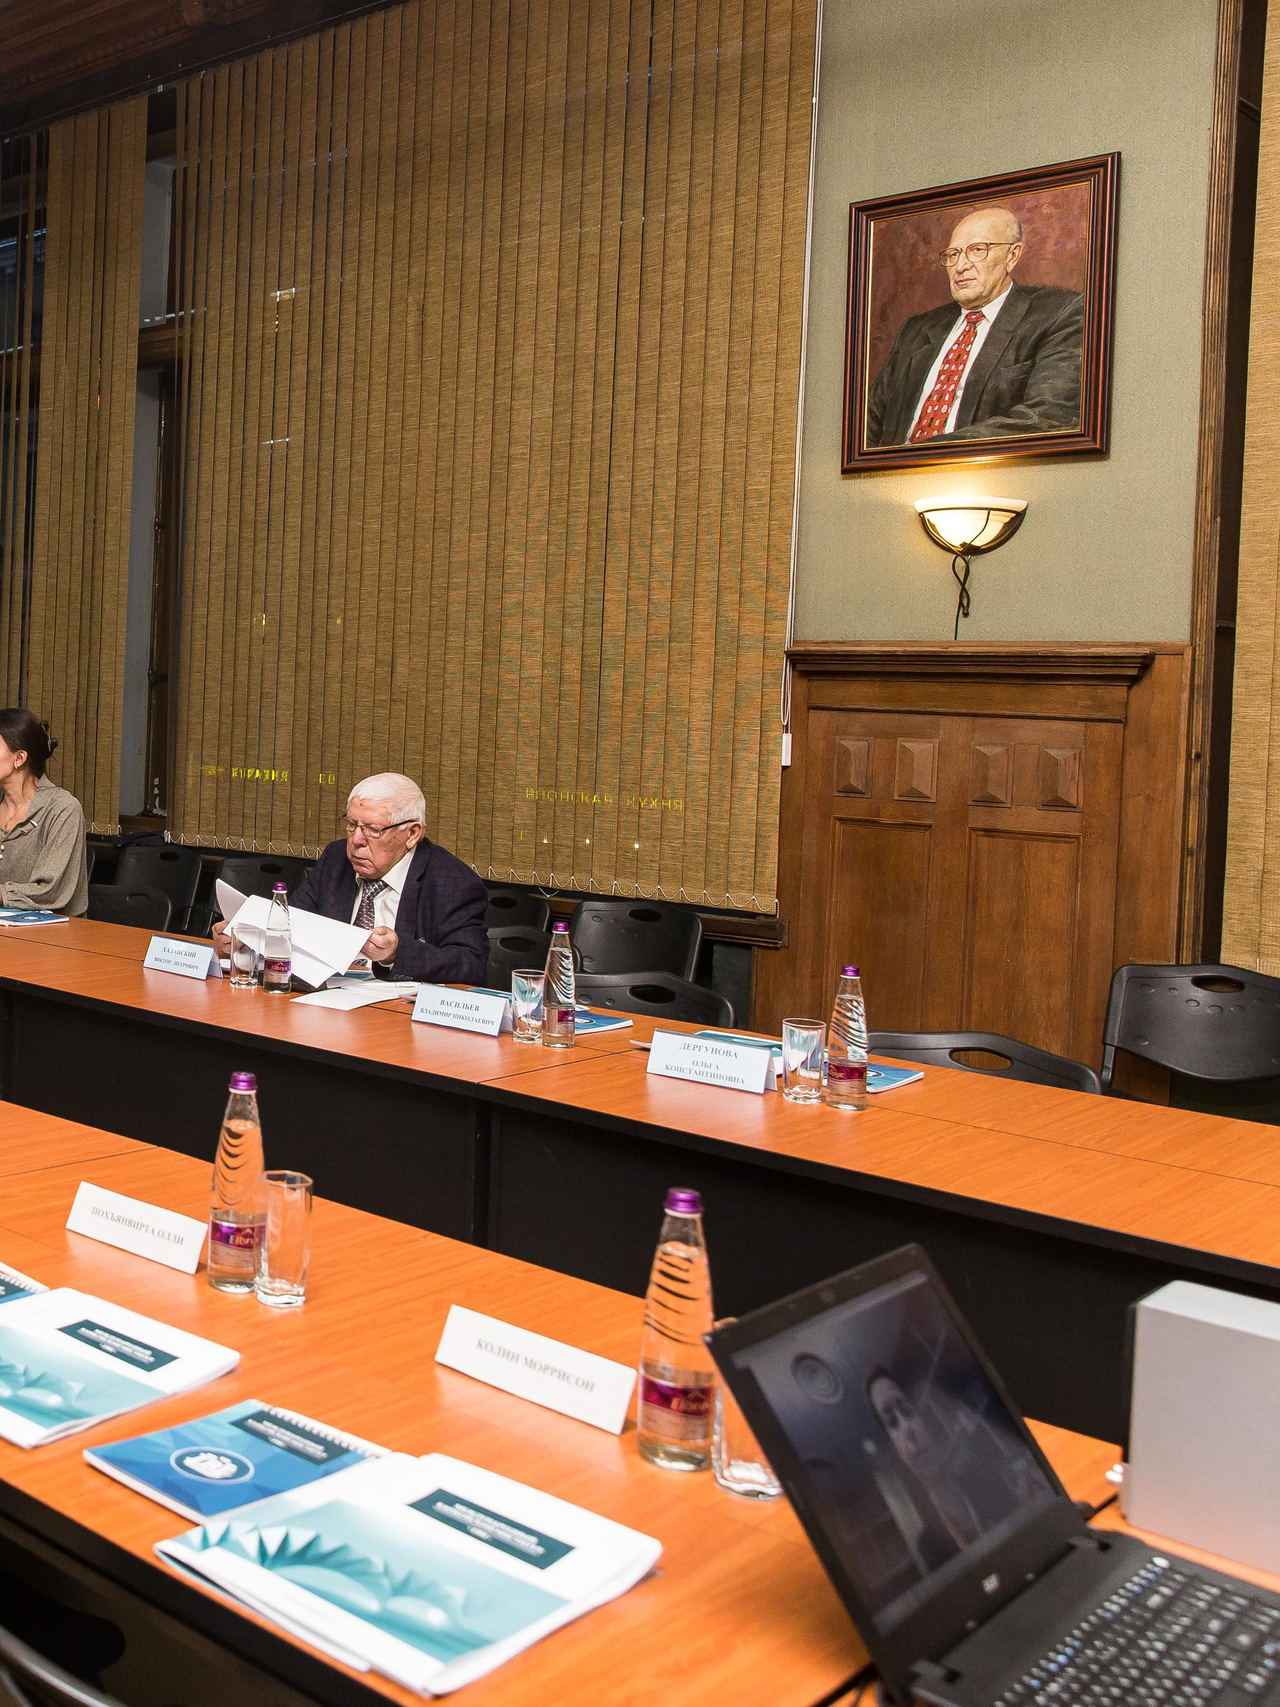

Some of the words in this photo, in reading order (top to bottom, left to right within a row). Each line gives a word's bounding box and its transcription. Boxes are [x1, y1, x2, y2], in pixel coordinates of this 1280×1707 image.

[440, 999, 480, 1012] ВАСИЛЬЕВ
[420, 1007, 452, 1018] ВЛАДИМИР
[452, 1013, 495, 1026] НИКОЛАЕВИЧ
[679, 1042, 738, 1059] ДЕРГУНОВА
[665, 1064, 745, 1085] КОНСТАНТИНОВНА
[692, 1060, 720, 1070] ОЛЬГА
[91, 1206, 155, 1236] ПОХЪЯНВИРТА
[157, 1230, 184, 1246] ОЛЛИ
[476, 1338, 520, 1363] КОЛИН
[520, 1356, 596, 1392] МОРРИСОН
